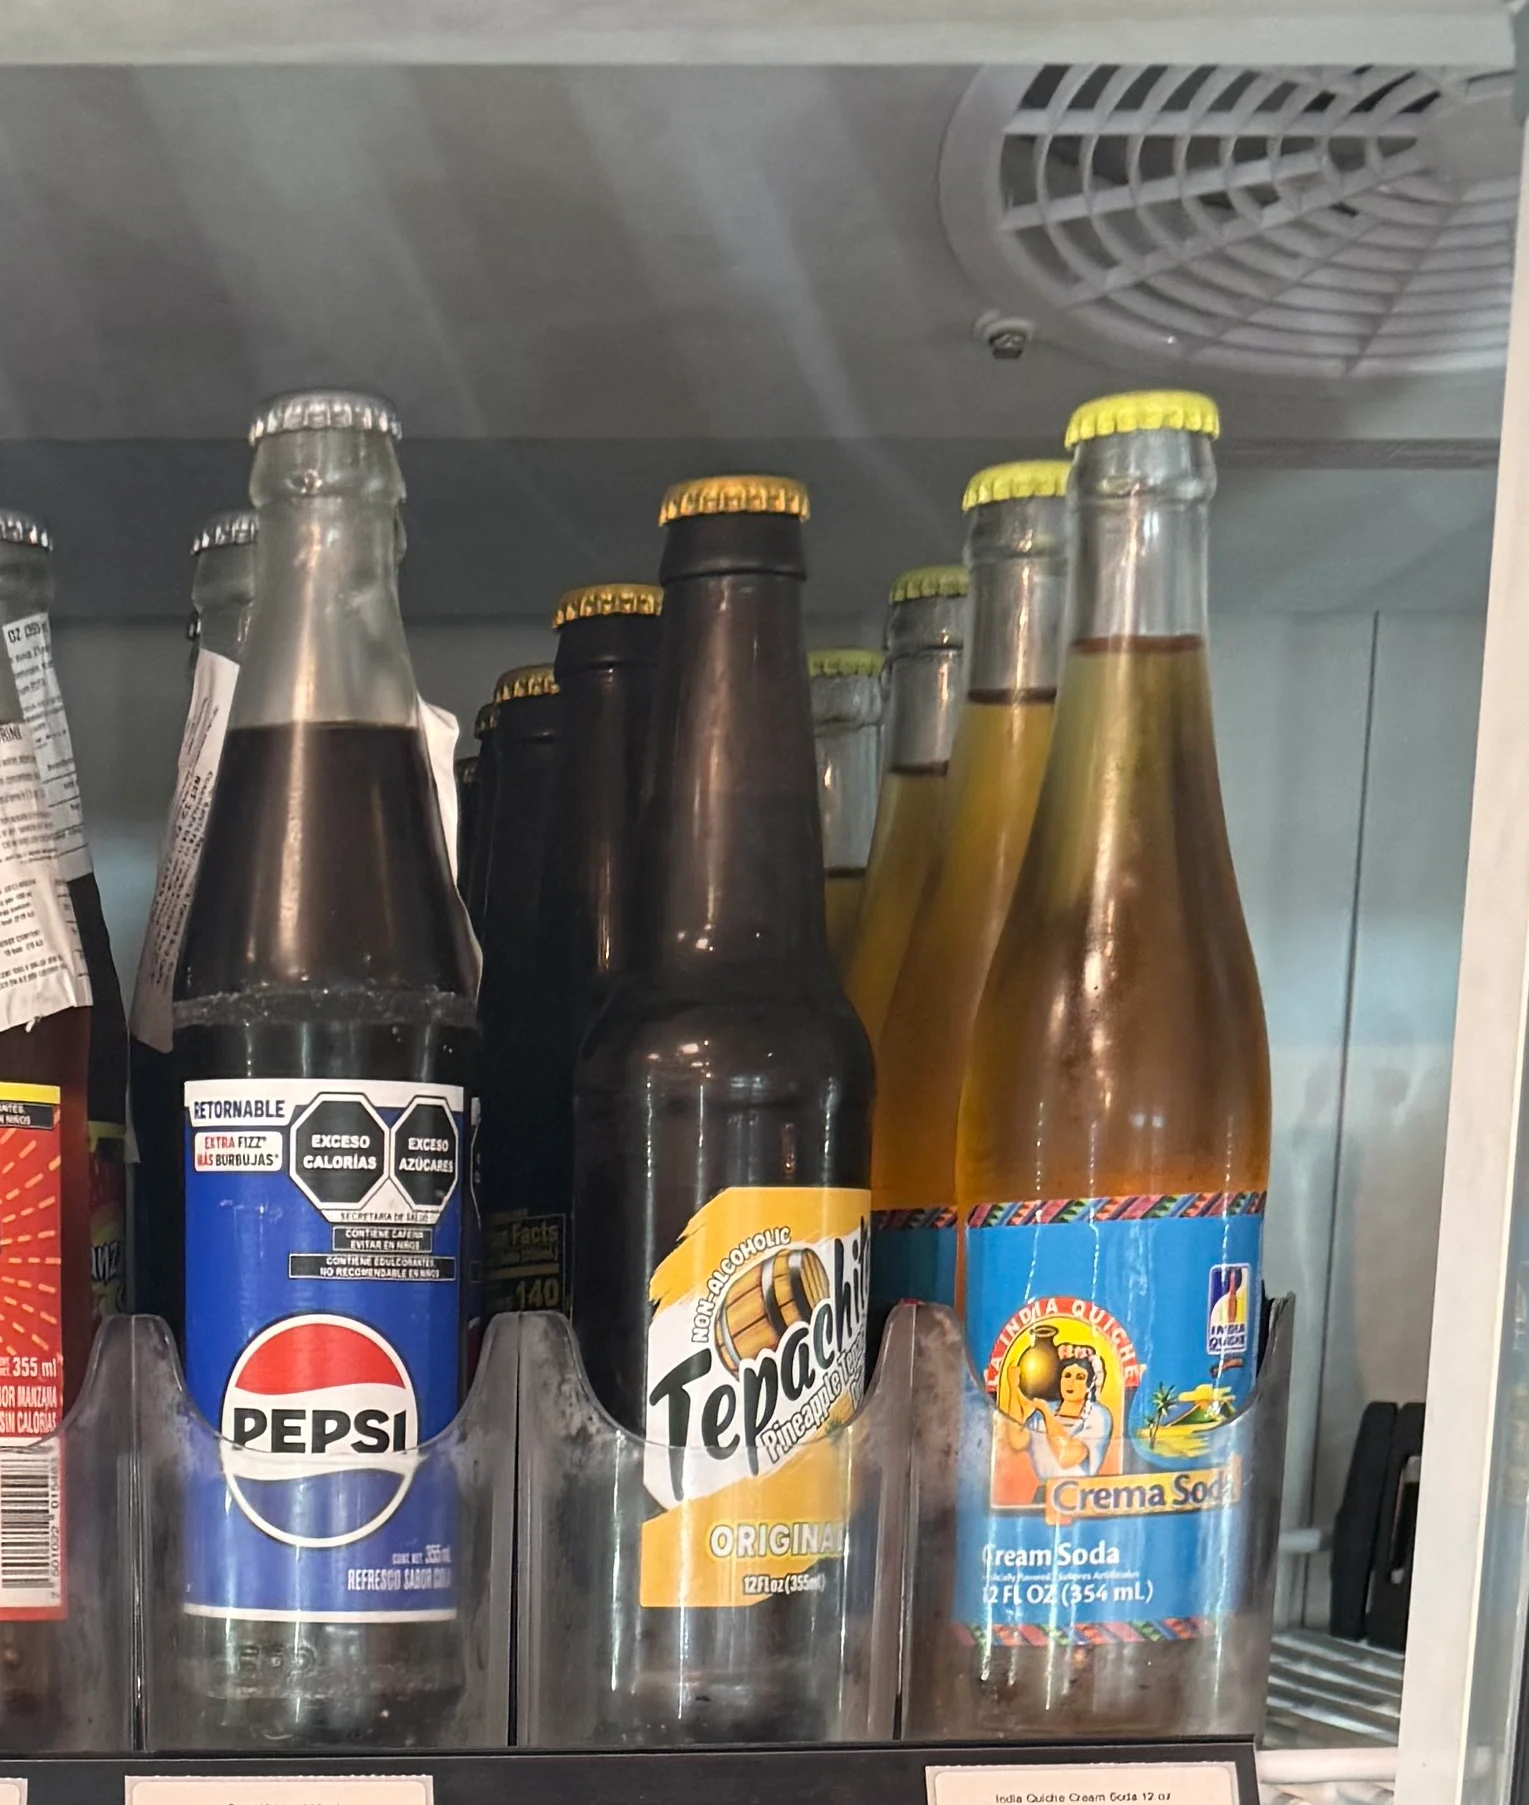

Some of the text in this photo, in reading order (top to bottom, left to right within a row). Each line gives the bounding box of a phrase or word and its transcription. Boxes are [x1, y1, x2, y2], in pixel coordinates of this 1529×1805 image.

[193, 1100, 285, 1120] RETORNABLE
[311, 1134, 370, 1150] EXCESO
[408, 1137, 449, 1153] EXCESO
[303, 1154, 377, 1171] CALORÍAS
[399, 1155, 454, 1174] AZÚCARES
[345, 1228, 389, 1240] CONTIENE
[511, 1221, 559, 1245] Facts
[350, 1240, 381, 1250] EVITAR
[326, 1256, 372, 1267] CONTIENE
[335, 1267, 407, 1279] RECOMENDABLE
[691, 1226, 793, 1344] NON-ALCOHOLIC
[997, 1297, 1141, 1382] INDIA QUICHE
[12, 1356, 38, 1378] 355
[17, 1385, 57, 1409] MANZANA
[760, 1370, 843, 1465] Pineapple
[233, 1407, 408, 1455] PEPSI
[1052, 1479, 1166, 1516] Crema
[1057, 1541, 1120, 1566] Soda
[348, 1568, 401, 1591] REFRESCO
[1062, 1581, 1108, 1607] (354
[1069, 1792, 1106, 1803] Cream
